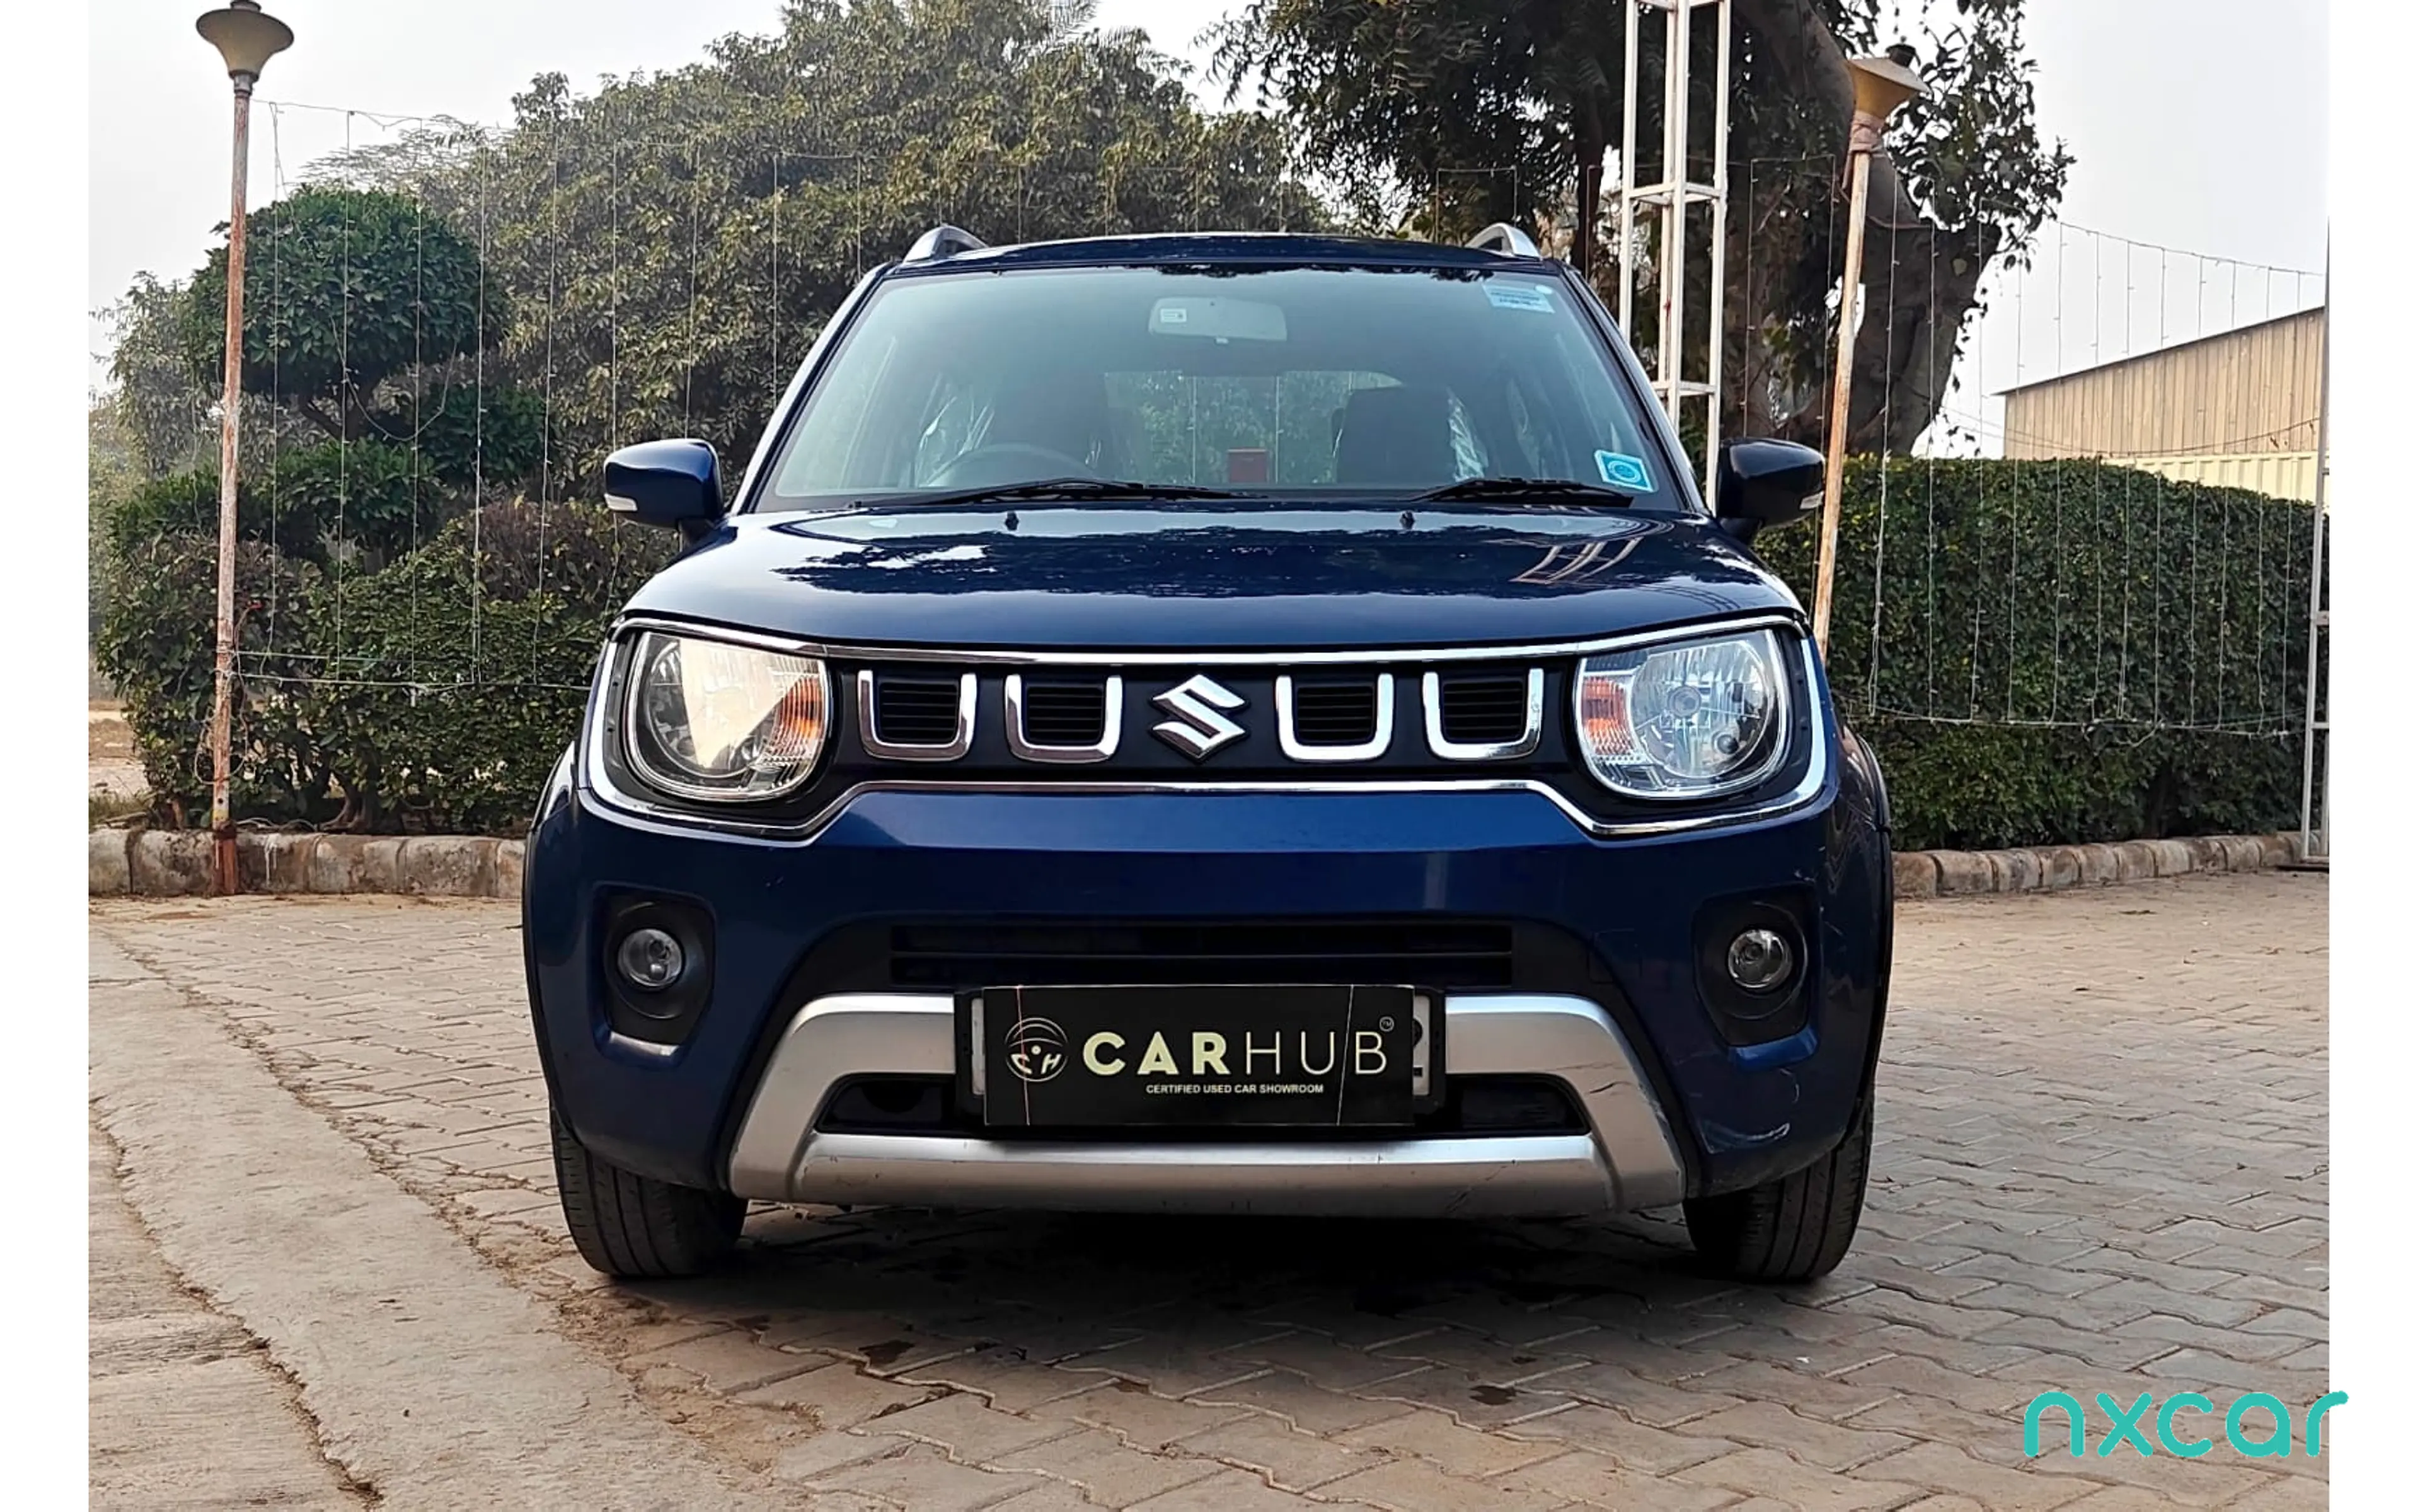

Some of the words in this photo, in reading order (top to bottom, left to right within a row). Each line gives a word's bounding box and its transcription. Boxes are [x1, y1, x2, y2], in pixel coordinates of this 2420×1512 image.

[1083, 1031, 1387, 1076] CARHUB
[1146, 1084, 1201, 1094] CERTIFIED
[1202, 1084, 1232, 1094] USED
[1234, 1084, 1257, 1094] CAR
[1259, 1084, 1324, 1094] SHOWROOM
